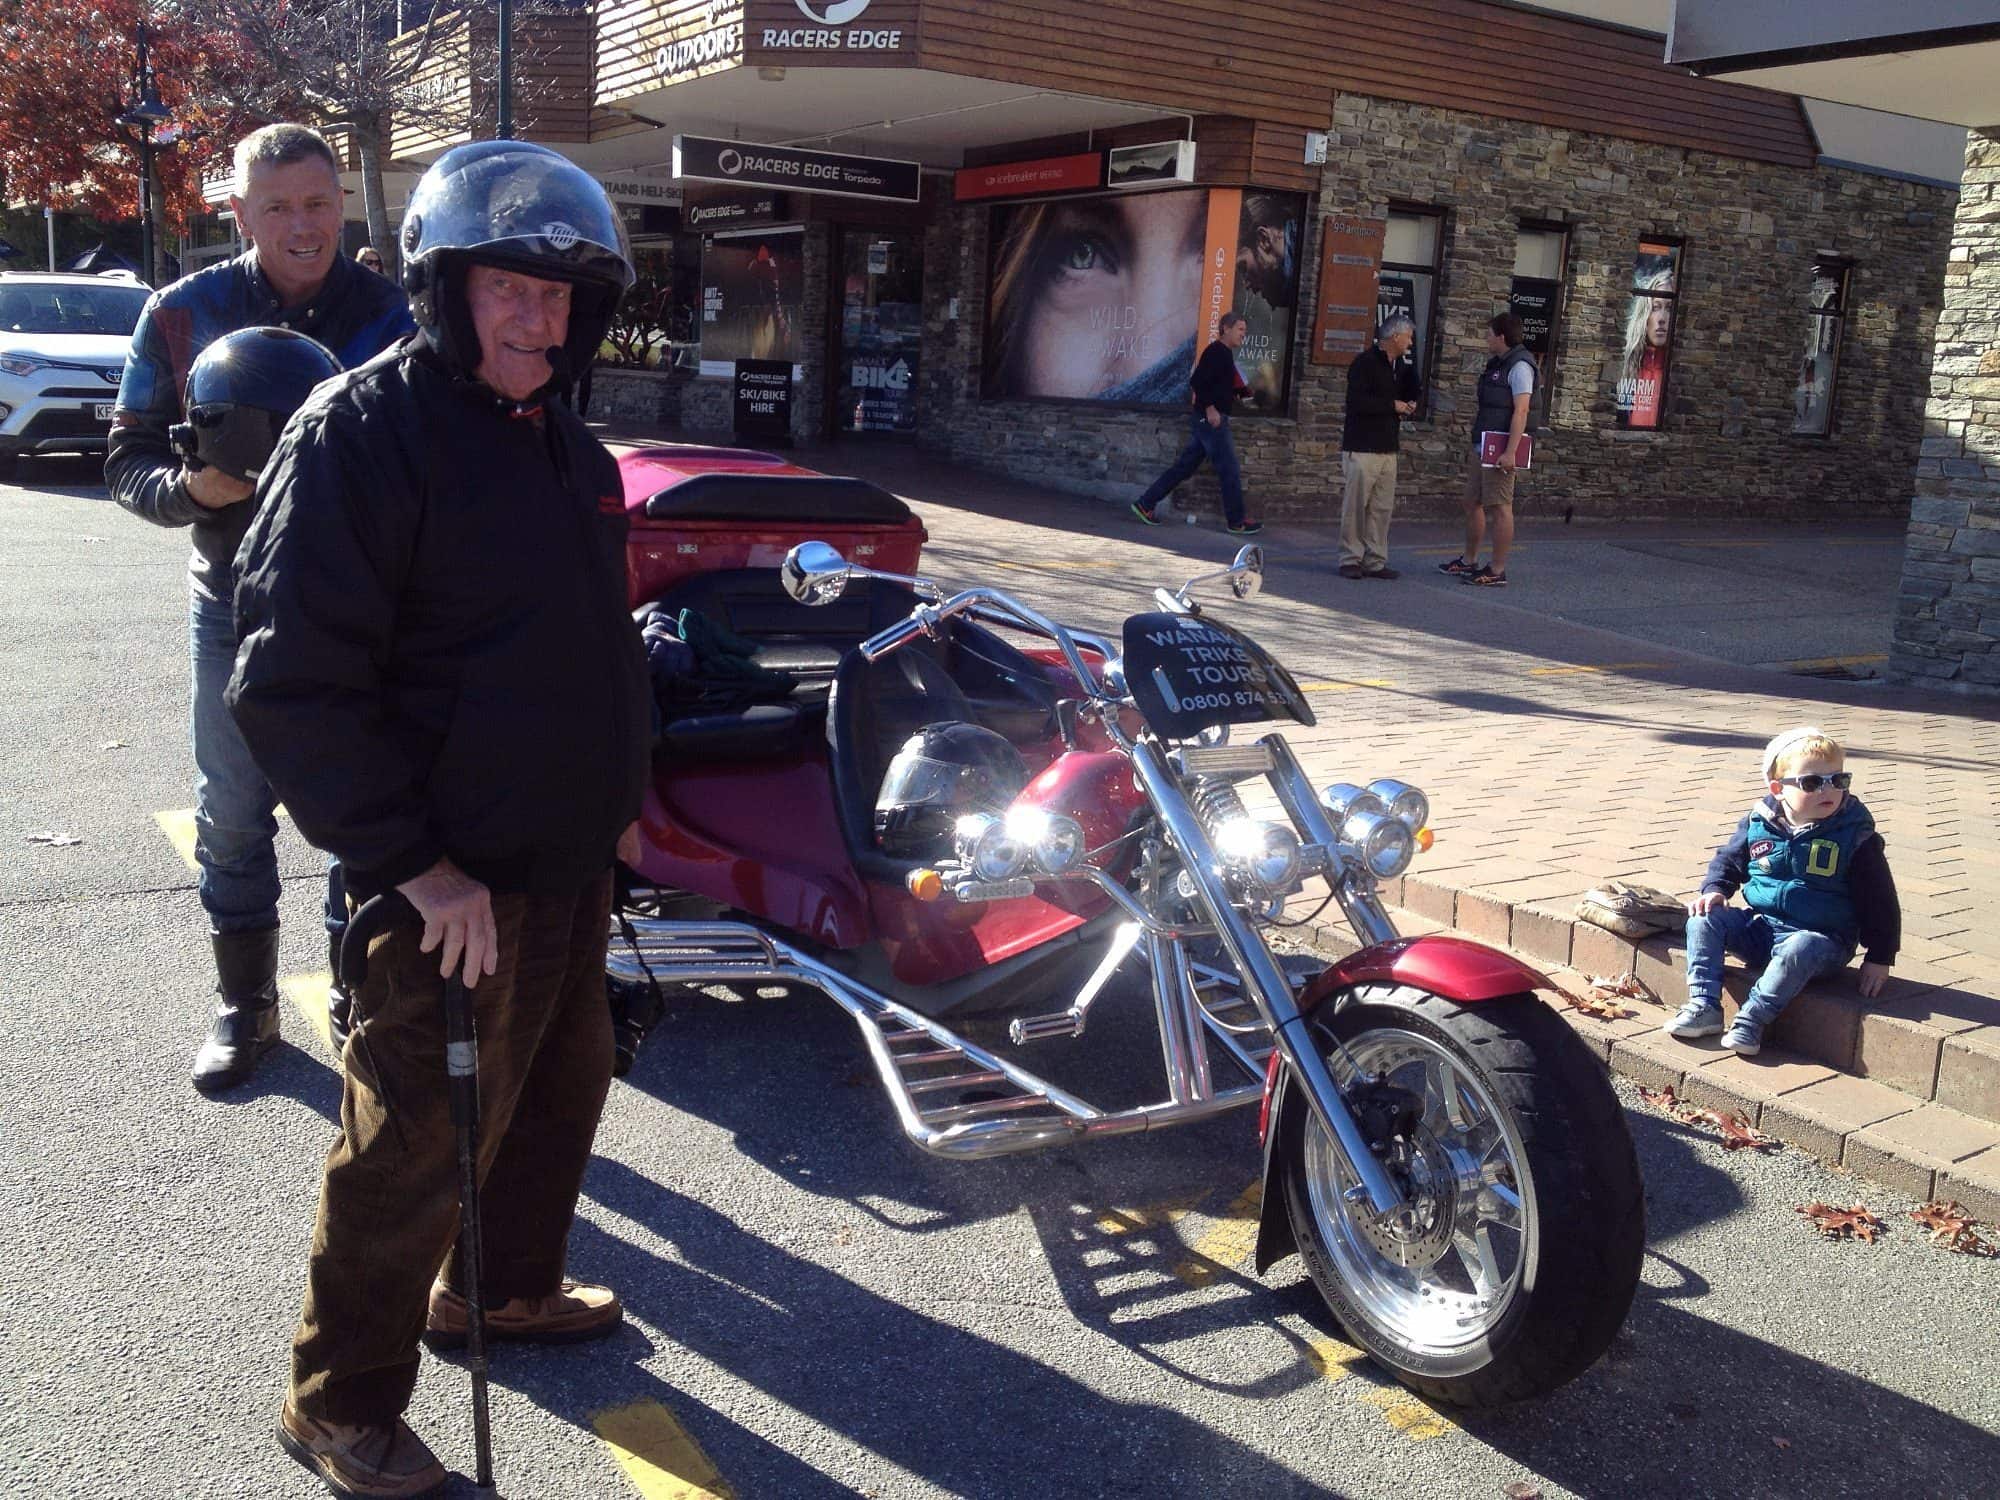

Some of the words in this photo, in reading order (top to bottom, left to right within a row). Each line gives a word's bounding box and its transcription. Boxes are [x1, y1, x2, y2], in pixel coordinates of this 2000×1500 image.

[762, 29, 841, 49] RACERS
[847, 30, 902, 49] EDGE
[656, 24, 738, 74] OUTDOORS
[744, 156, 800, 176] RACERS
[803, 163, 841, 180] EDGE
[1333, 222, 1345, 233] 99
[1090, 306, 1137, 329] WILD
[1241, 335, 1269, 347] WILD
[1239, 348, 1278, 361] AWAKE
[851, 357, 909, 390] BIKE
[739, 388, 787, 401] SKI/BIKE
[1620, 377, 1655, 395] WARM
[750, 402, 775, 413] HIRE
[1145, 629, 1241, 646] WANAK
[1179, 646, 1252, 664] TRIKE
[1186, 666, 1267, 686] TOURS
[1181, 692, 1232, 711] 0800
[1234, 690, 1265, 705] 874
[1806, 838, 1840, 878] D
